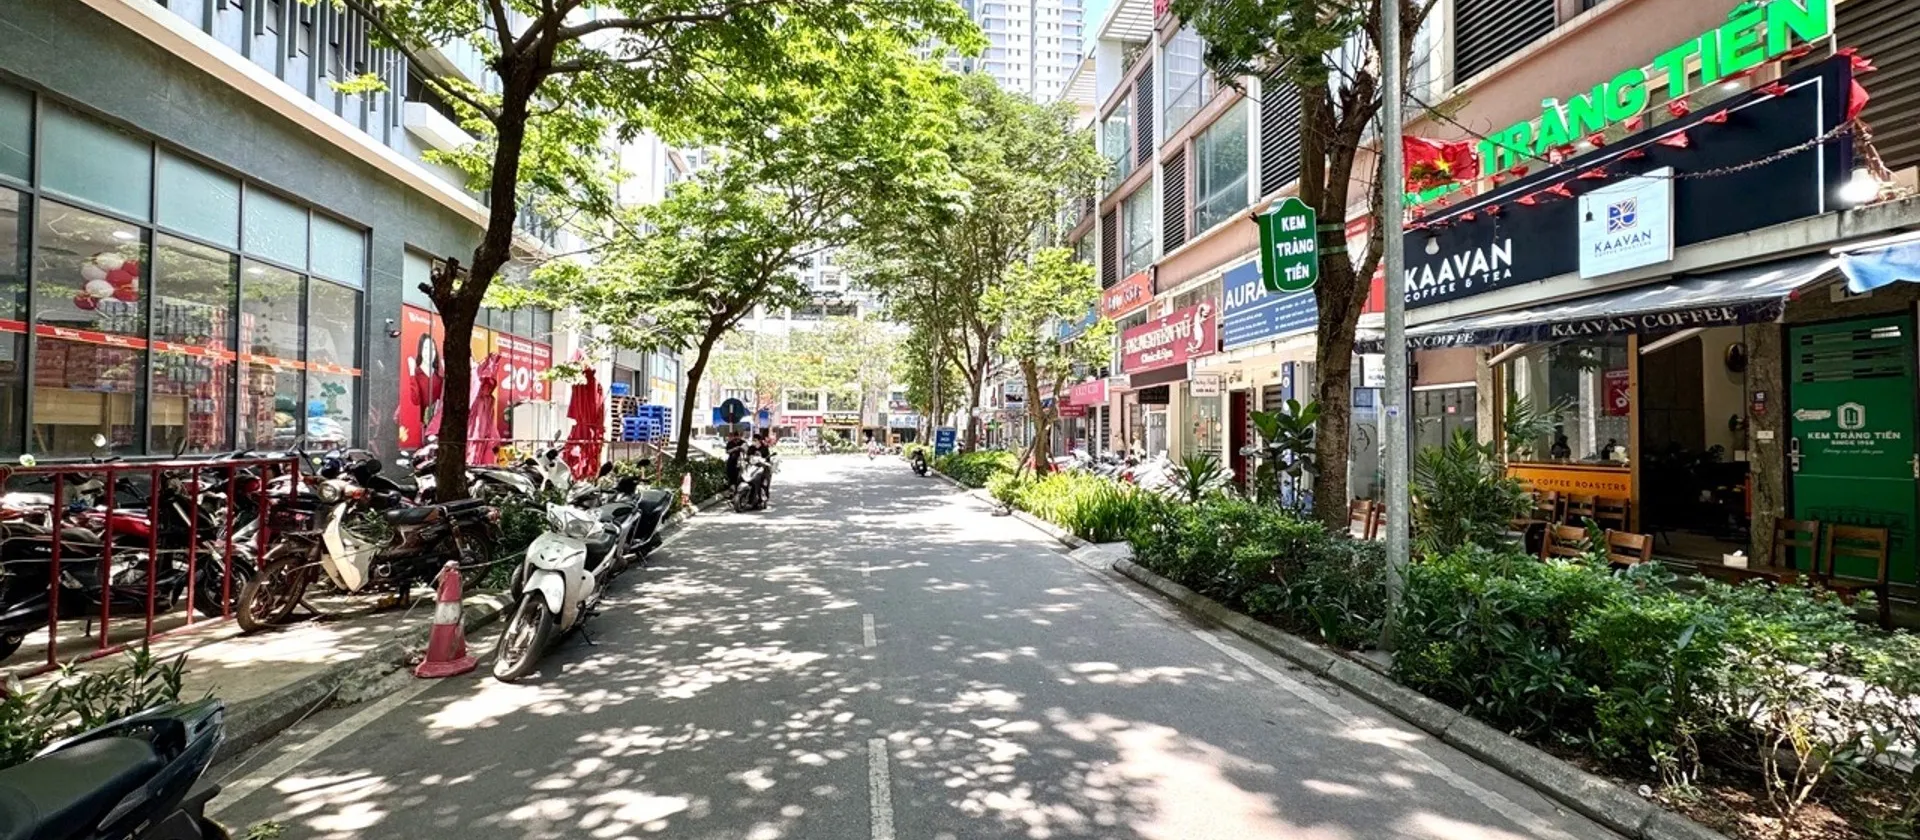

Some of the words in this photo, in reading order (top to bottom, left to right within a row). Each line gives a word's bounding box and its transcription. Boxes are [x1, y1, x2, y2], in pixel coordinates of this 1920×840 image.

[1281, 214, 1306, 232] KEM
[1594, 229, 1652, 253] KAAVAN
[1404, 238, 1512, 293] KAAVAN
[1224, 277, 1268, 311] AURA
[1404, 282, 1456, 303] COFFEE
[1464, 278, 1473, 288] &
[1482, 268, 1512, 283] TEA
[1551, 316, 1637, 337] KAAVAN
[1642, 307, 1739, 328] COFFEE
[1538, 478, 1571, 487] COFFEE
[1575, 481, 1627, 491] ROASTERS
